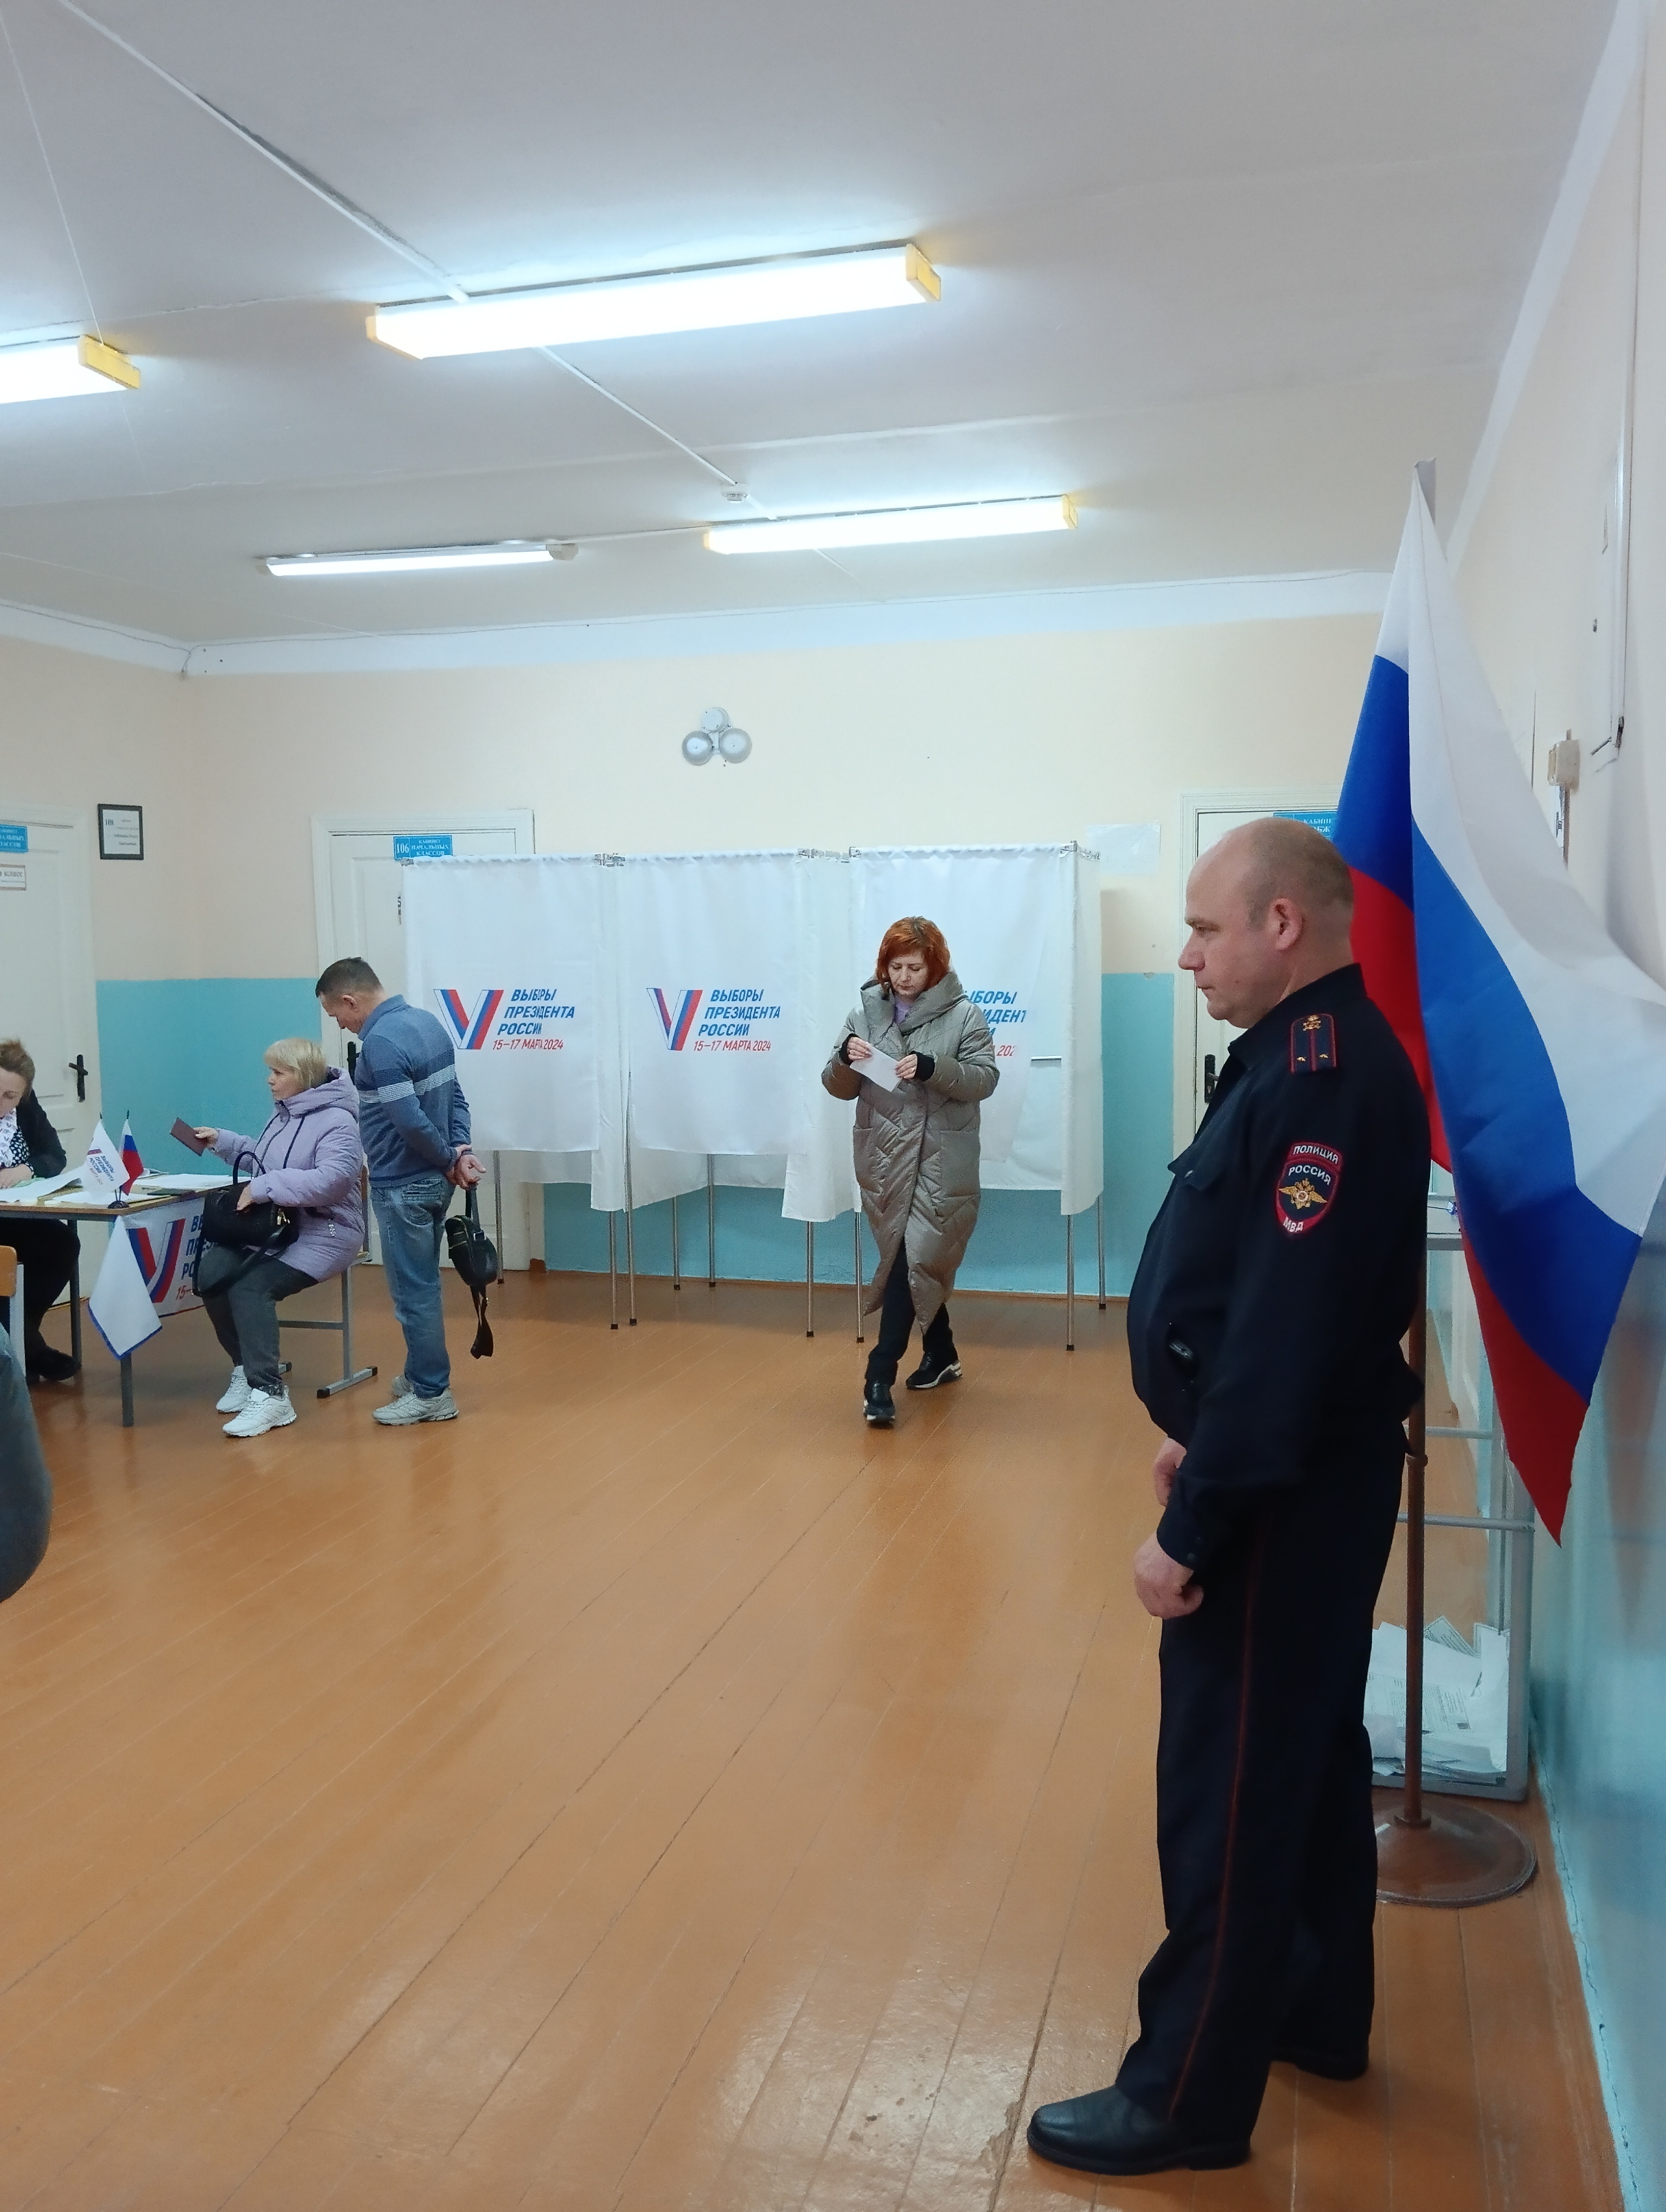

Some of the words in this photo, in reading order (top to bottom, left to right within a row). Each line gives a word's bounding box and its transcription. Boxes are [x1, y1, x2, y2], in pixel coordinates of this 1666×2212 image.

[396, 843, 409, 853] 106
[710, 989, 764, 1002] ВЫБОРЫ
[965, 990, 1017, 1004] ЫБОРЫ
[504, 1006, 575, 1019] ПРЕЗИДЕНТА
[704, 1006, 781, 1020] ПРЕЗИДЕНТА
[497, 1023, 542, 1035] РОССИИ
[699, 1024, 750, 1036] РОССИИ
[543, 1039, 563, 1050] 2024
[722, 1040, 751, 1051] МАРТА
[752, 1040, 771, 1051] 2024
[1293, 1145, 1338, 1164] ПОЛИЦИЯ
[1288, 1165, 1331, 1185] РОССИЯ
[1283, 1216, 1304, 1232] МВД
